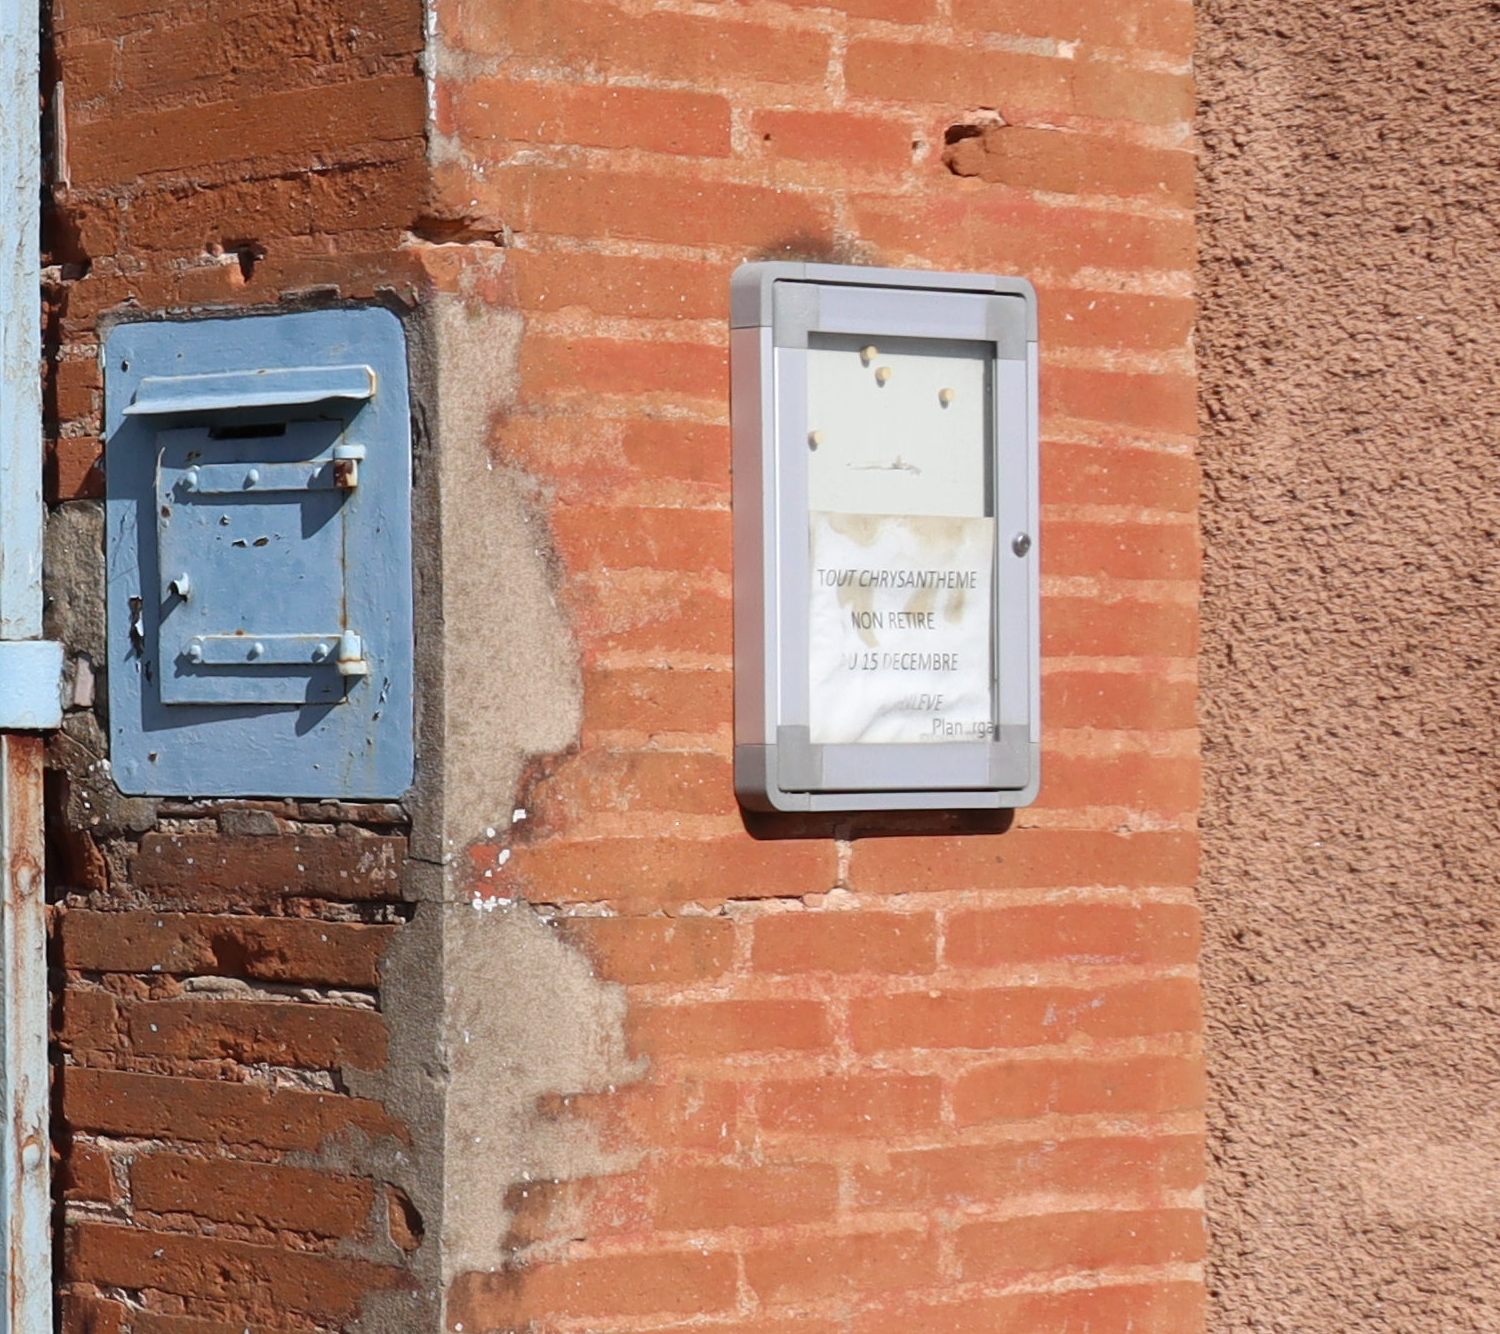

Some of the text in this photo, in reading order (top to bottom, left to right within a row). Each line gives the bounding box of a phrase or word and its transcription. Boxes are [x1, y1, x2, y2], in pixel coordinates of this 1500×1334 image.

[817, 569, 979, 589] TOUT CHRYSANTHEME
[851, 611, 936, 630] NON RETIRE
[861, 653, 879, 670] 15
[883, 653, 959, 671] DECEMBRE
